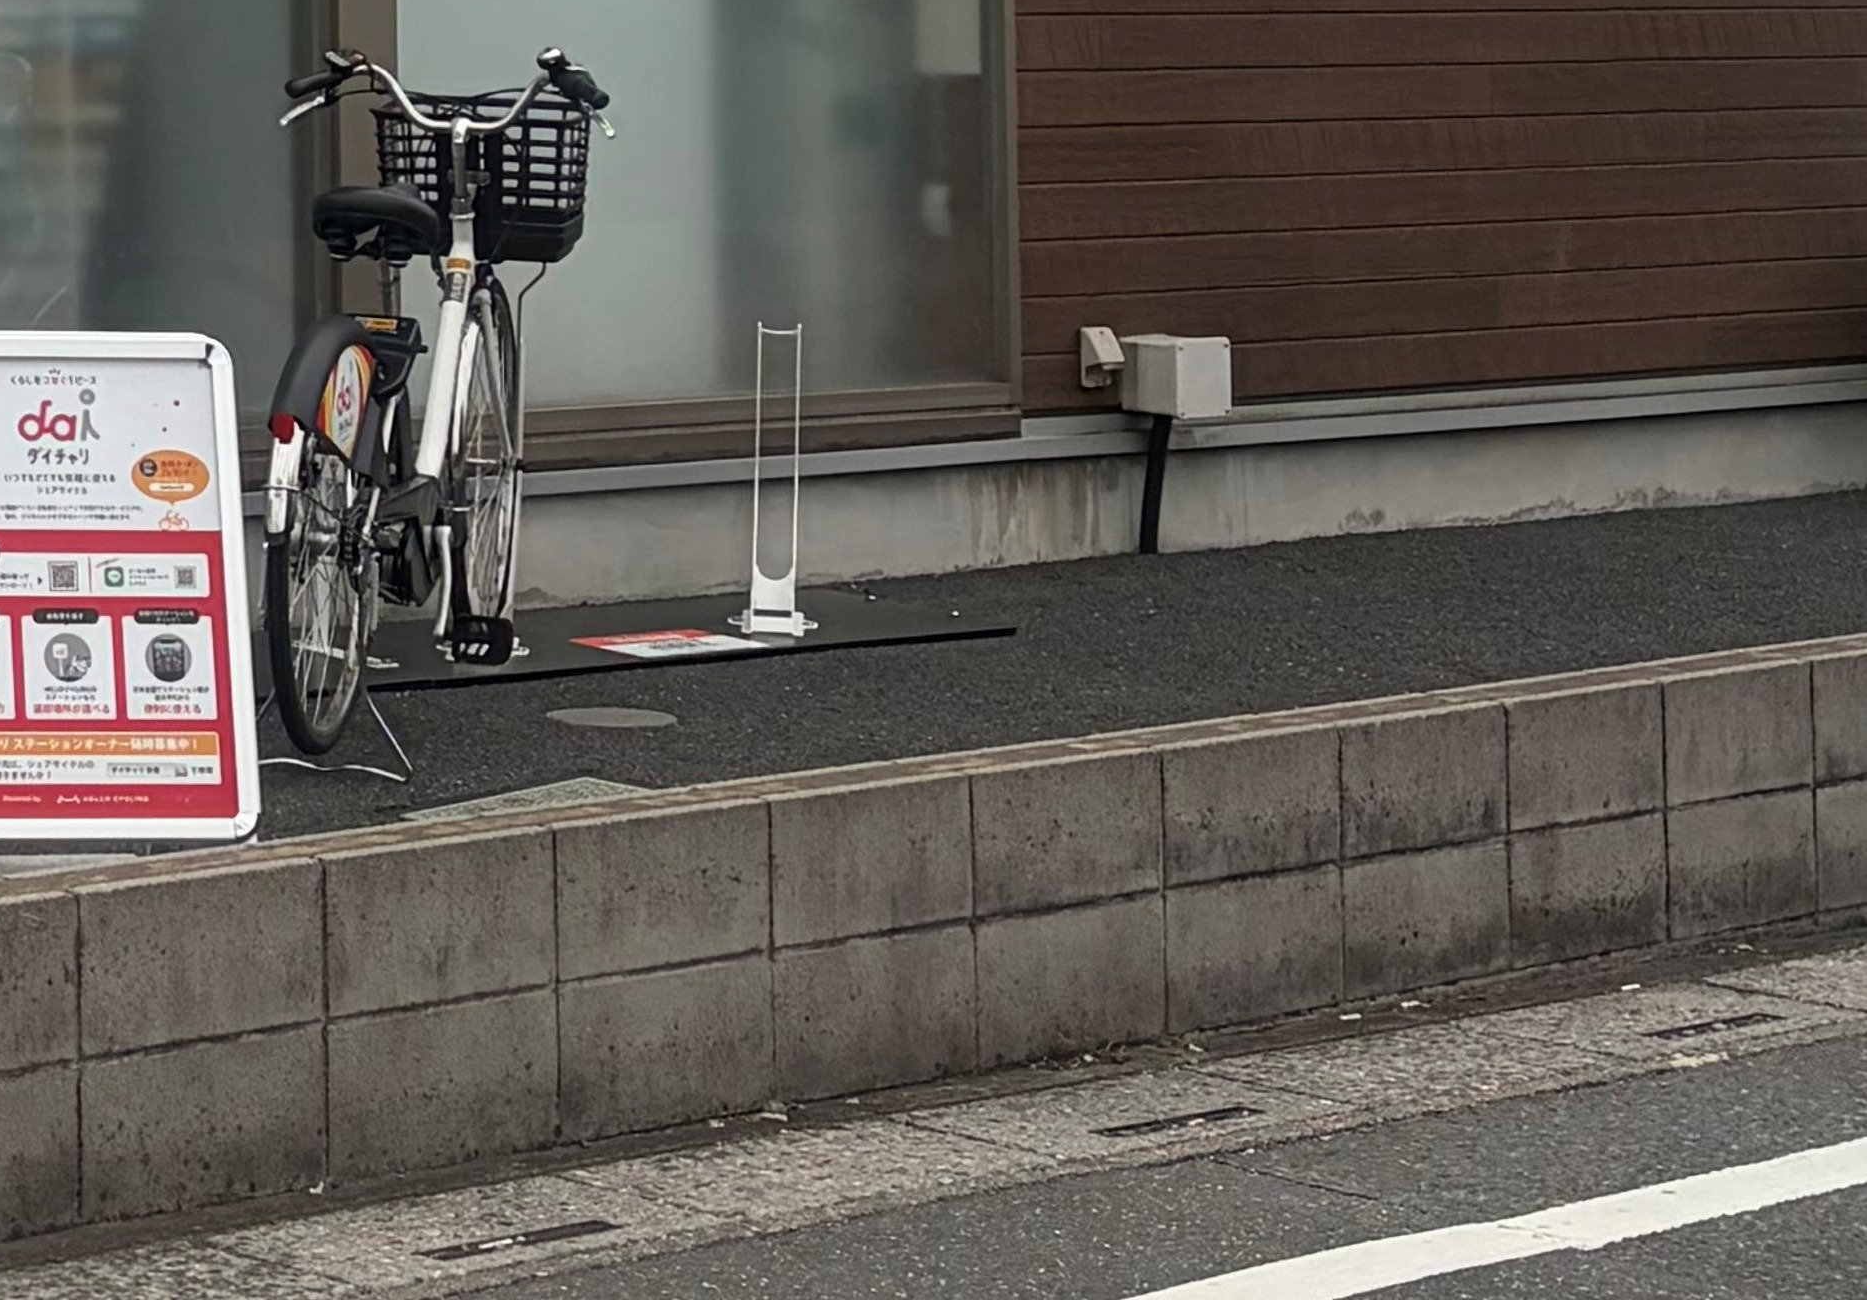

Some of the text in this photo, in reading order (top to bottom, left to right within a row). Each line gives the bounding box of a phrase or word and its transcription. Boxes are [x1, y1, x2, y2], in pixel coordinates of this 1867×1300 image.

[27, 447, 90, 465] ダイチャリ
